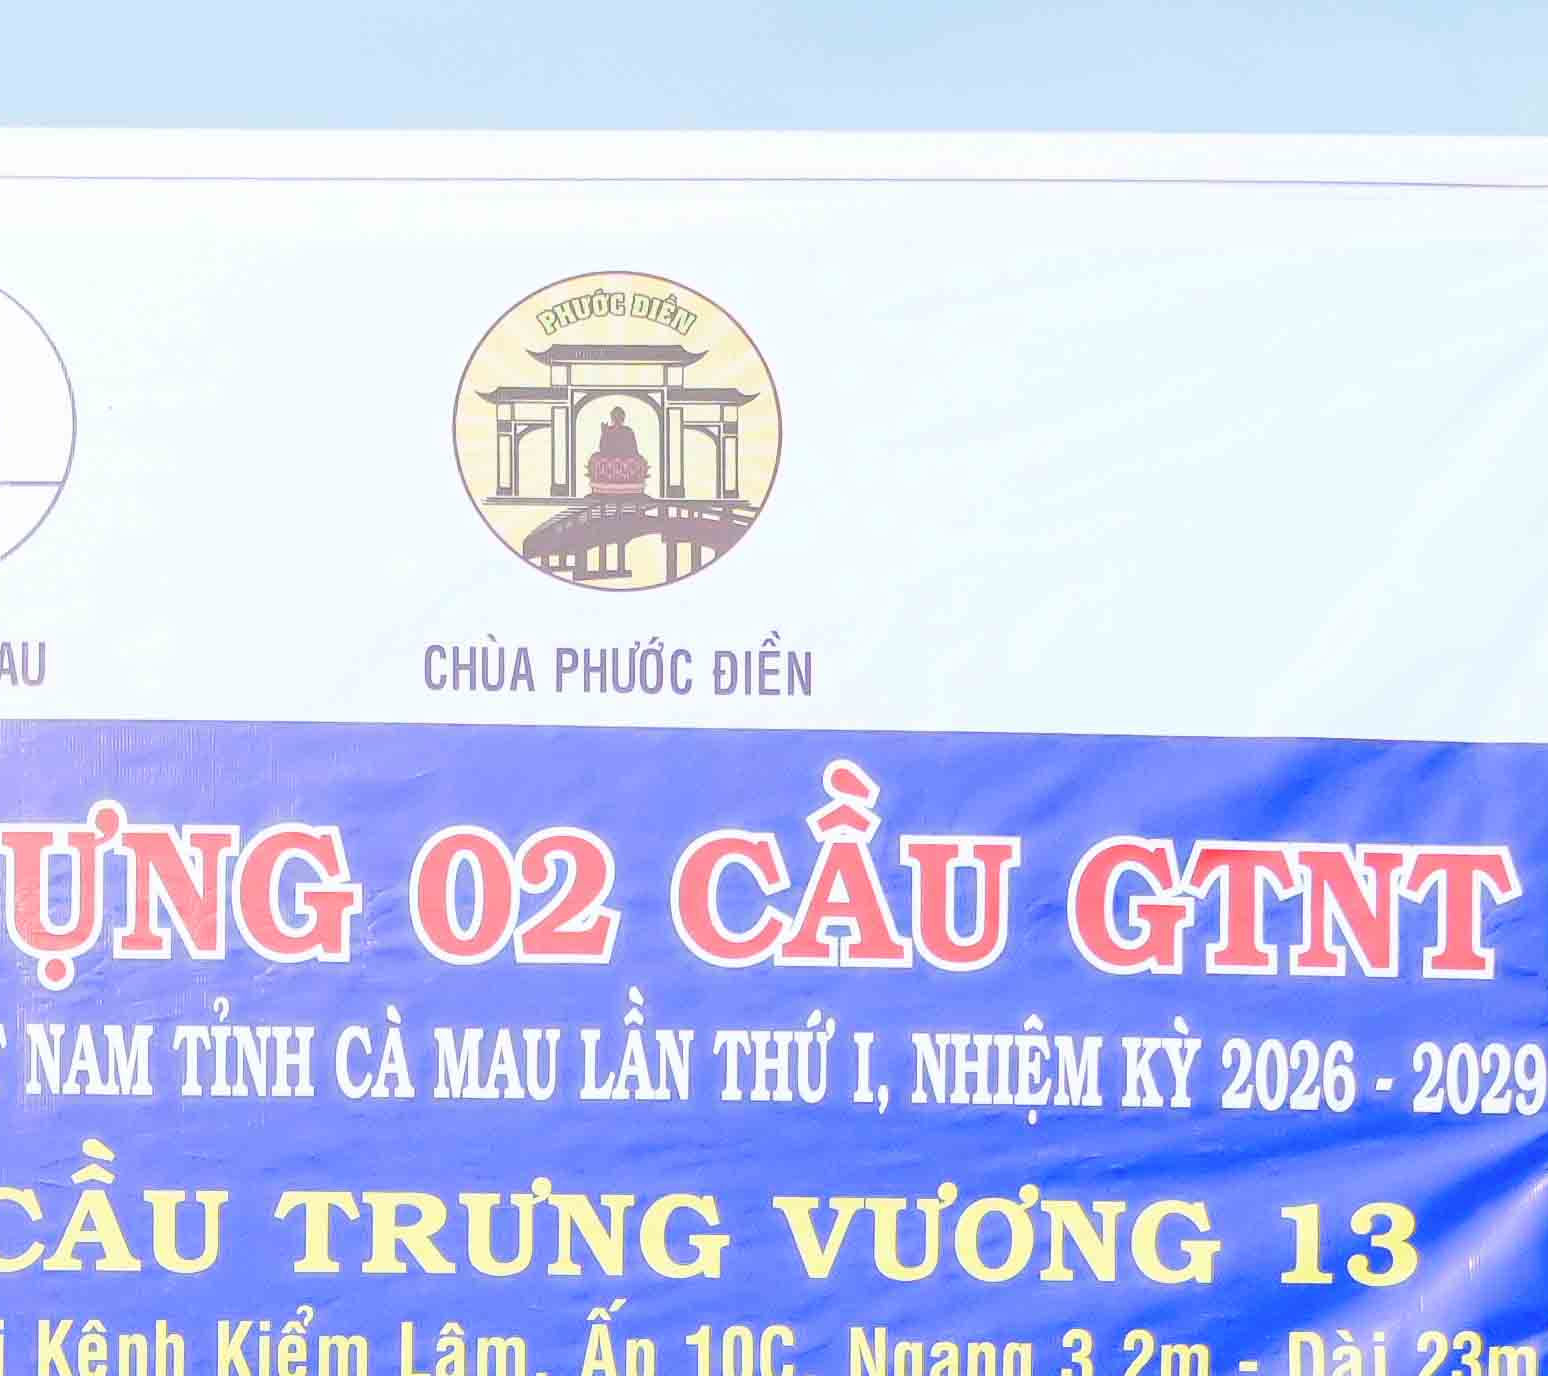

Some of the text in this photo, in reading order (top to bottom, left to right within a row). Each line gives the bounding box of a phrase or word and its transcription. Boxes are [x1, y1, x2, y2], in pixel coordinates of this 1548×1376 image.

[536, 288, 625, 335] PHƯỚC
[424, 630, 813, 697] CHÙA PHƯỚC ĐIỀN
[410, 823, 623, 966] 02
[671, 758, 1023, 974] CẦU
[1068, 834, 1522, 980] GTNT
[25, 1023, 153, 1096] NAM
[173, 997, 315, 1097] TỈNH
[336, 1004, 415, 1099] CÀ
[433, 1027, 557, 1101] MAU
[580, 986, 692, 1102] LẦN
[713, 1011, 839, 1104] THỨ
[853, 1037, 889, 1116] I,
[912, 1015, 1103, 1126] NHIỆM
[1121, 1016, 1202, 1111] KỲ
[1220, 1035, 1356, 1113] 2026
[1412, 1041, 1548, 1116] 2029
[274, 1176, 729, 1278] TRƯNG
[772, 1180, 1221, 1284] VƯƠNG
[1279, 1200, 1419, 1287] 13
